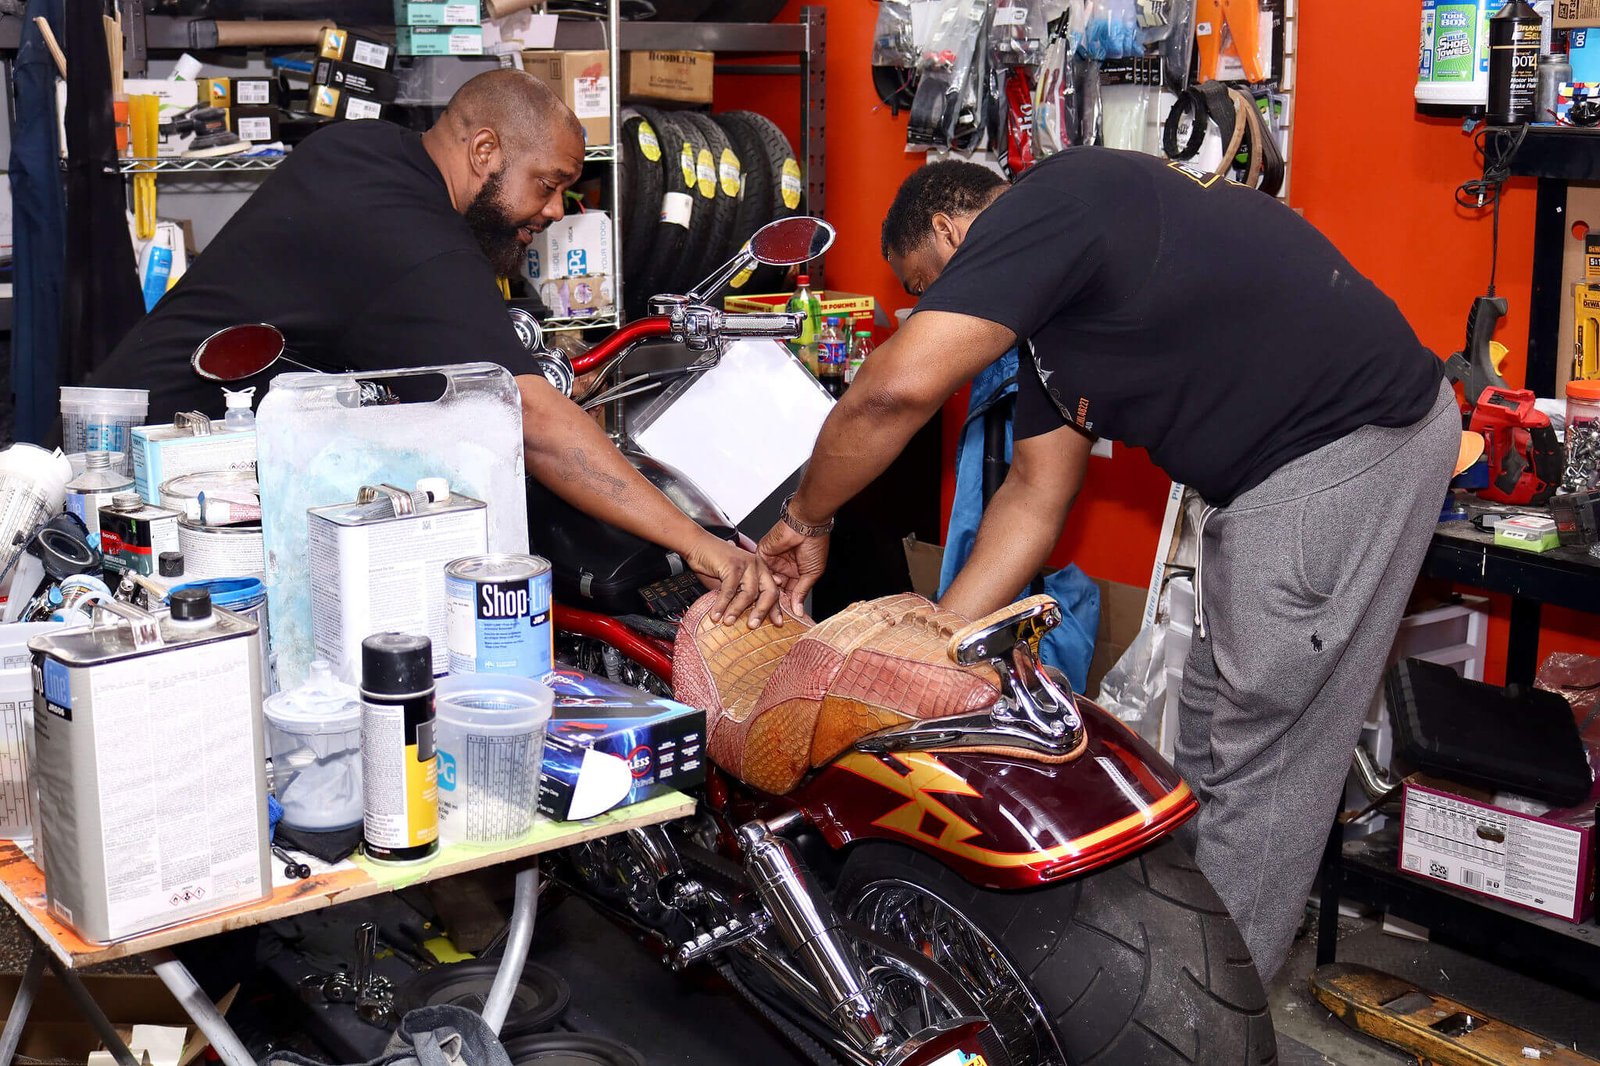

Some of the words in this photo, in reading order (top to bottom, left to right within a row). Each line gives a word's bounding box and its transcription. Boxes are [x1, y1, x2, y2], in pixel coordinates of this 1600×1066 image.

[1439, 37, 1469, 50] SHOP
[1576, 31, 1586, 47] 100
[1436, 44, 1471, 61] TOWELS
[568, 250, 586, 275] PPG
[102, 532, 117, 540] bondo
[482, 584, 527, 618] Shop
[532, 578, 550, 612] Lin
